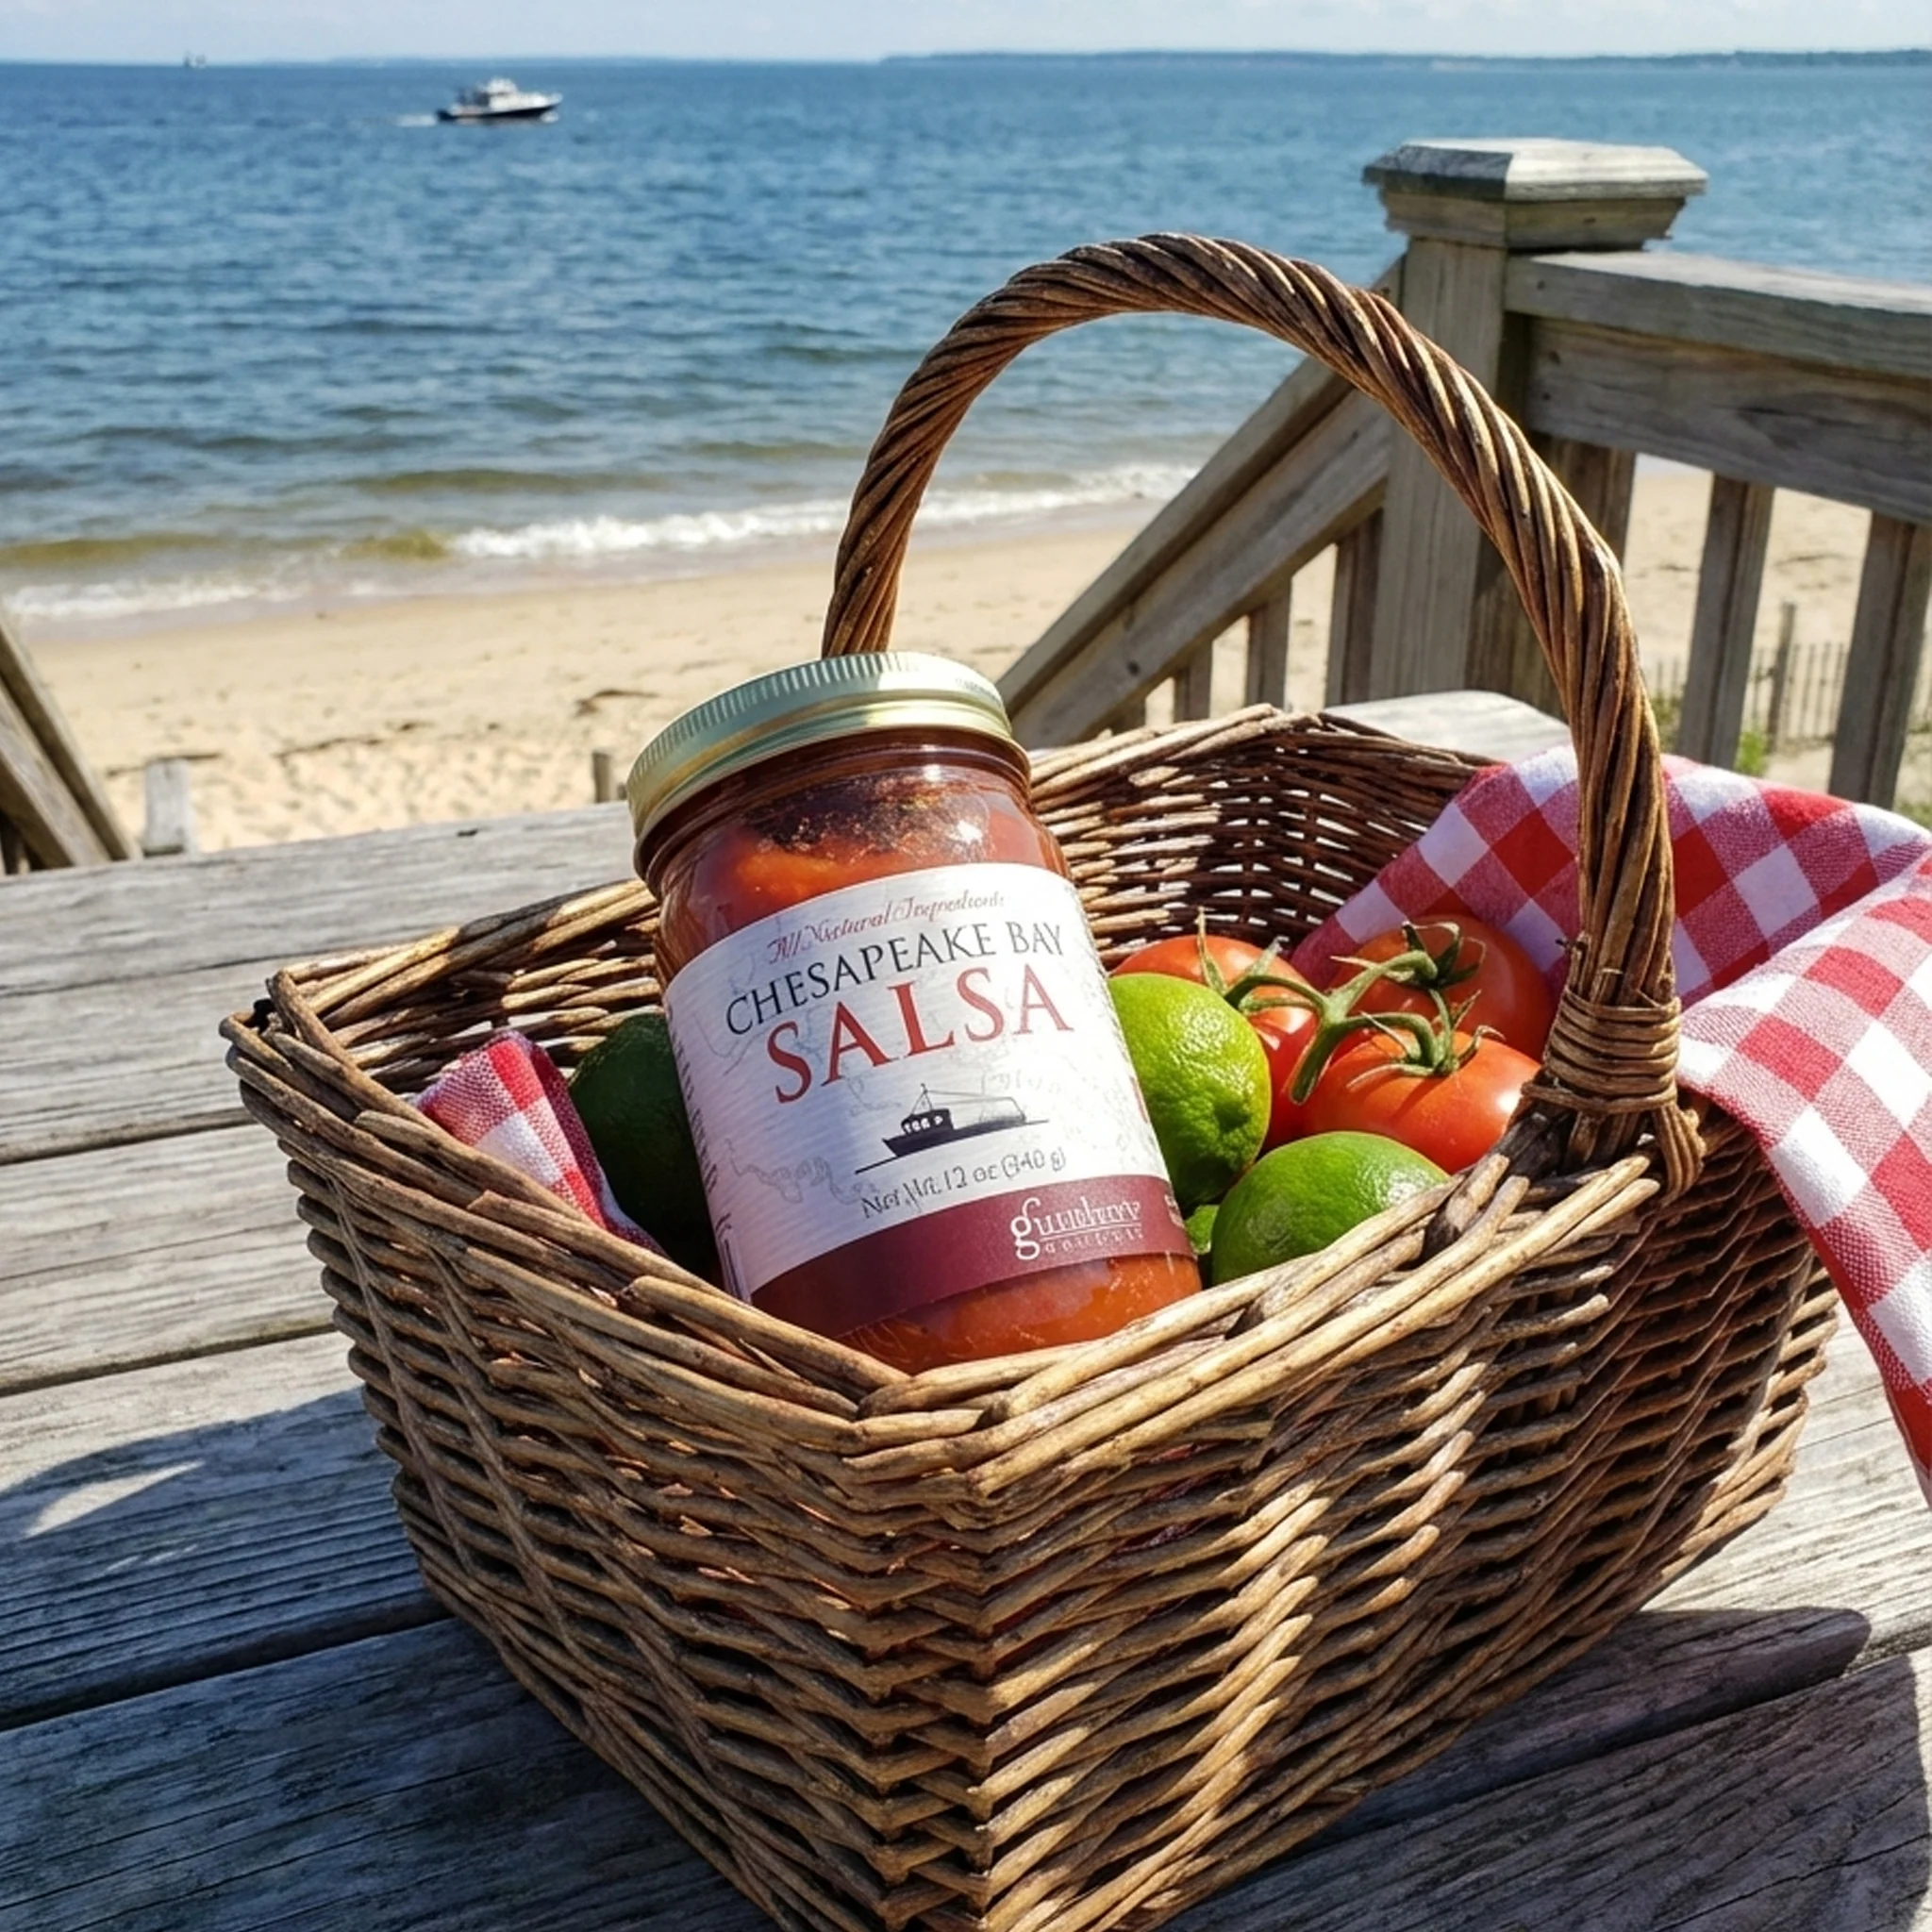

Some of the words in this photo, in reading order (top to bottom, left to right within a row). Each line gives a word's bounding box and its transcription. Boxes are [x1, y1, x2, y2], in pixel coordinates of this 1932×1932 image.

[725, 923, 997, 1036] CHESAPEAKE
[1006, 921, 1064, 957] BAY
[766, 962, 1074, 1104] SALSA
[944, 1166, 968, 1191] 12
